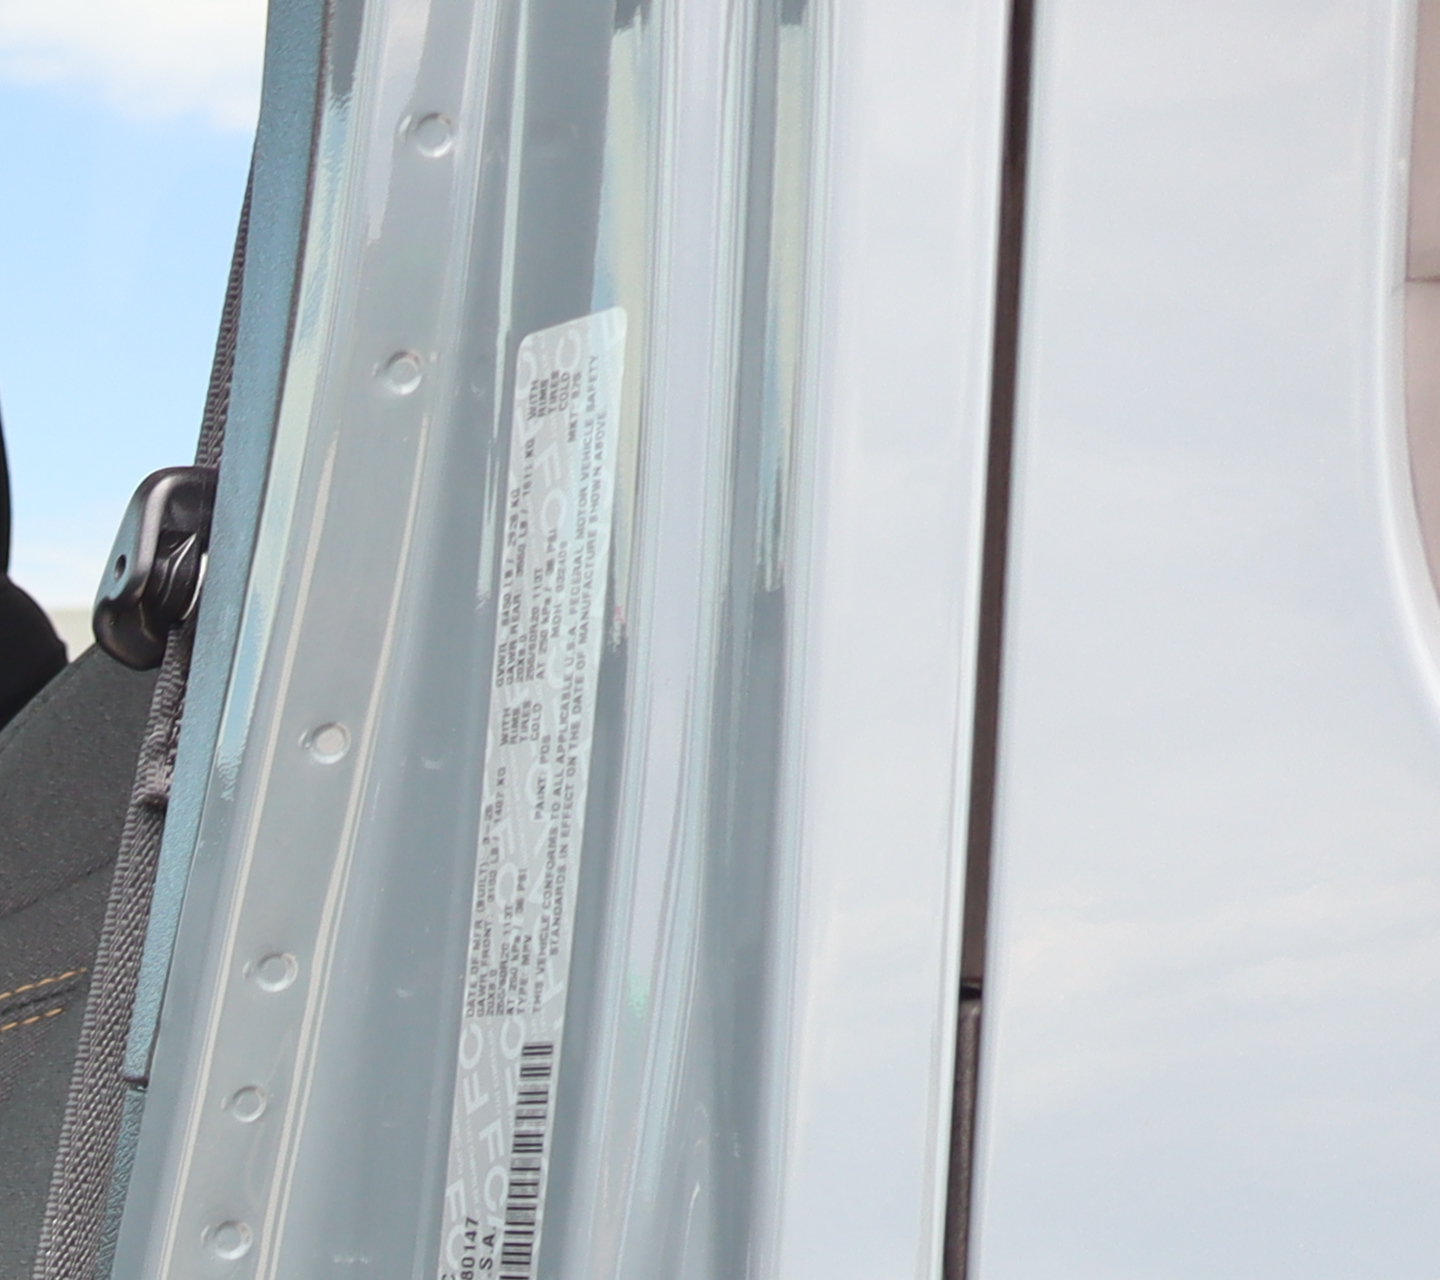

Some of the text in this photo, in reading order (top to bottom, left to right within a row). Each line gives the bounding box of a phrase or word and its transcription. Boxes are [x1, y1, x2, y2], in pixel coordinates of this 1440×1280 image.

[526, 379, 539, 421] WITH
[537, 379, 548, 417] RIMS
[547, 370, 559, 414] TIRES
[557, 371, 571, 412] COLD
[585, 355, 598, 412] SAFETY
[579, 418, 594, 482] VEHICLE
[575, 486, 588, 540] MOTOR
[568, 546, 584, 615] FEDERAL
[535, 662, 545, 680] AT
[499, 707, 510, 746] WITH
[509, 707, 520, 745] RIMS
[518, 700, 532, 743] TIRES
[529, 702, 543, 741] COLD
[549, 465, 602, 956] STANDARDS IN EFFECT ON THE DATE OF MANUFACTURE SHOWN
[555, 674, 573, 764] APPLICABLE
[552, 769, 564, 797] ALL
[550, 801, 561, 820] TO
[542, 827, 558, 909] CONFORMS
[472, 919, 483, 951] MFR
[521, 934, 532, 966] MPV
[535, 915, 550, 975] VEHICLE
[470, 958, 479, 975] OF
[465, 981, 478, 1018] DATE
[505, 1000, 514, 1016] AT
[531, 981, 544, 1014] THIS
